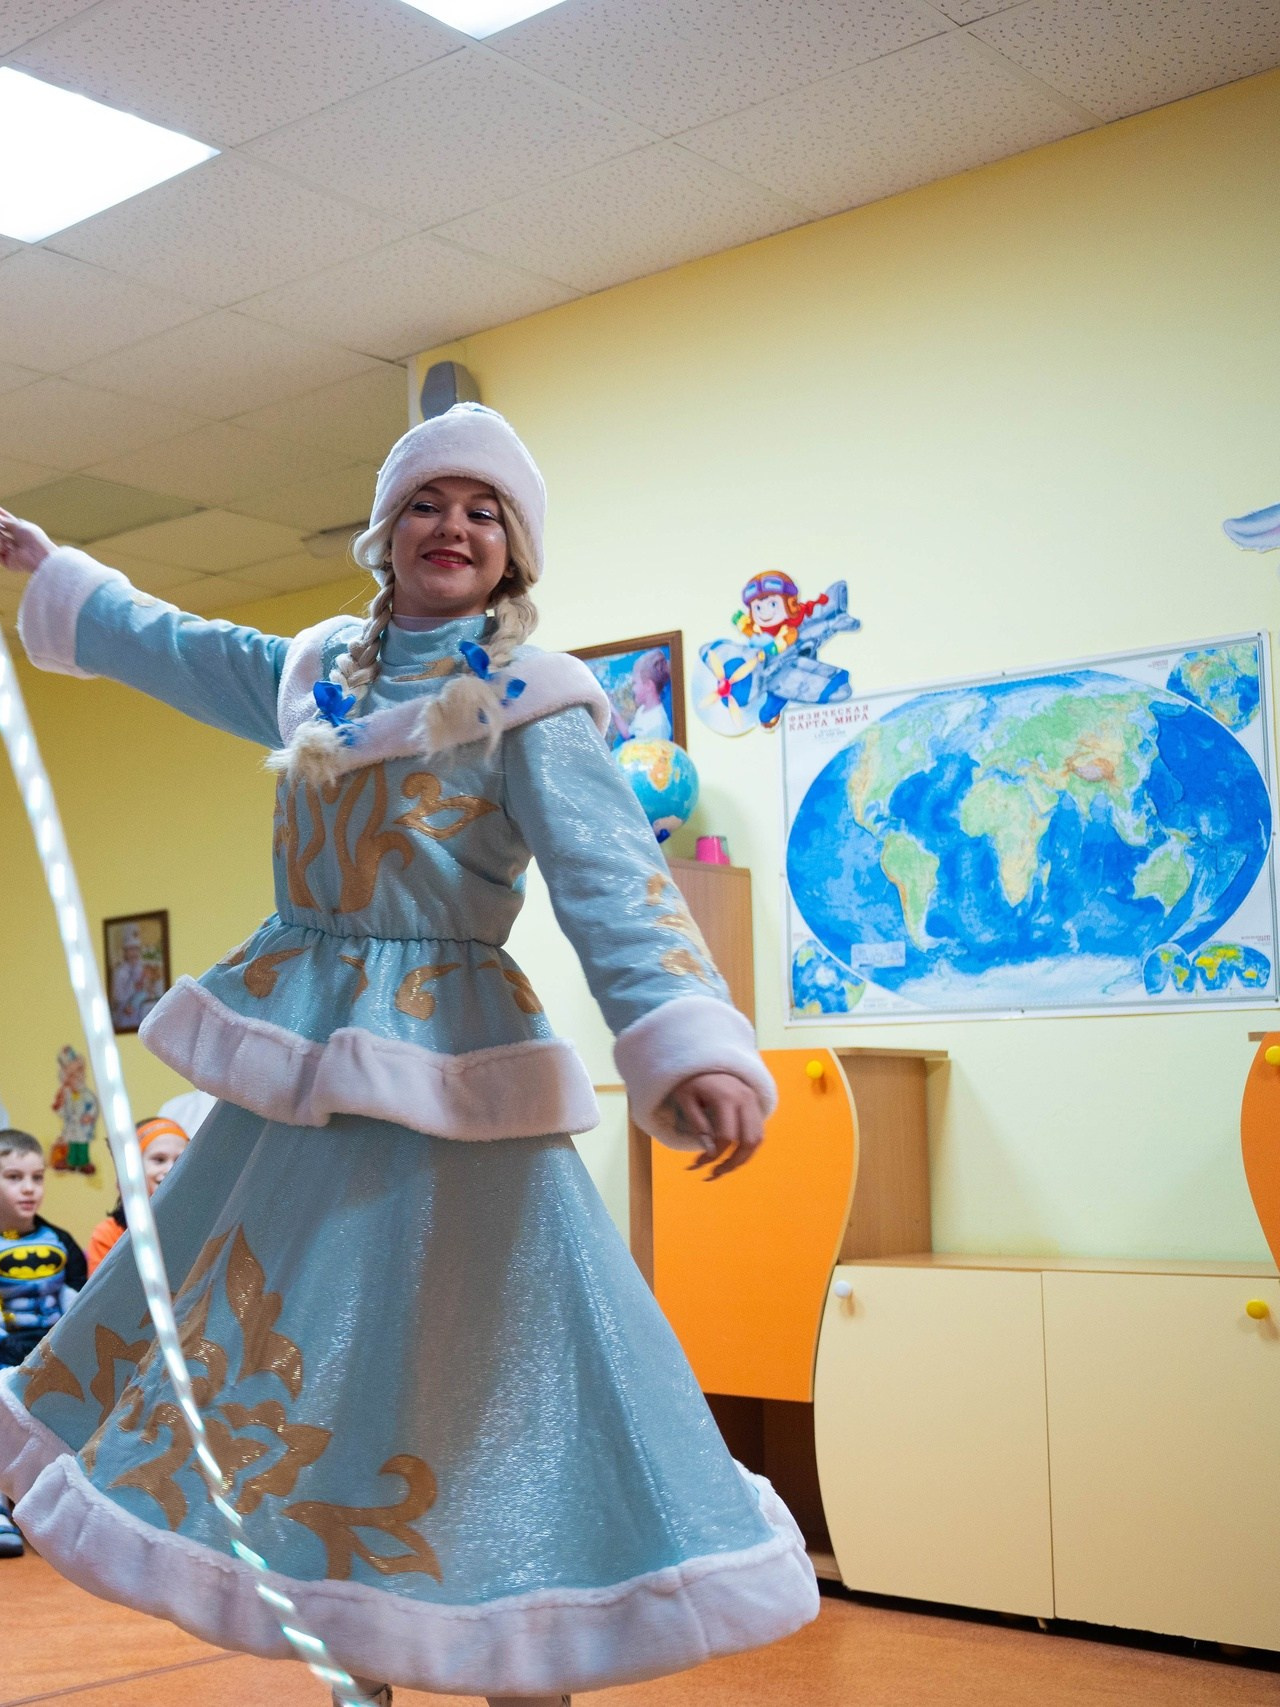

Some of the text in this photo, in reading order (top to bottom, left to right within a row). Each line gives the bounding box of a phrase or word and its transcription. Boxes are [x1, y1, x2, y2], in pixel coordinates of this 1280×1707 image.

[788, 704, 869, 721] ФИЗИЧЕСКАЯ
[789, 713, 869, 732] КАРТА МИРА
